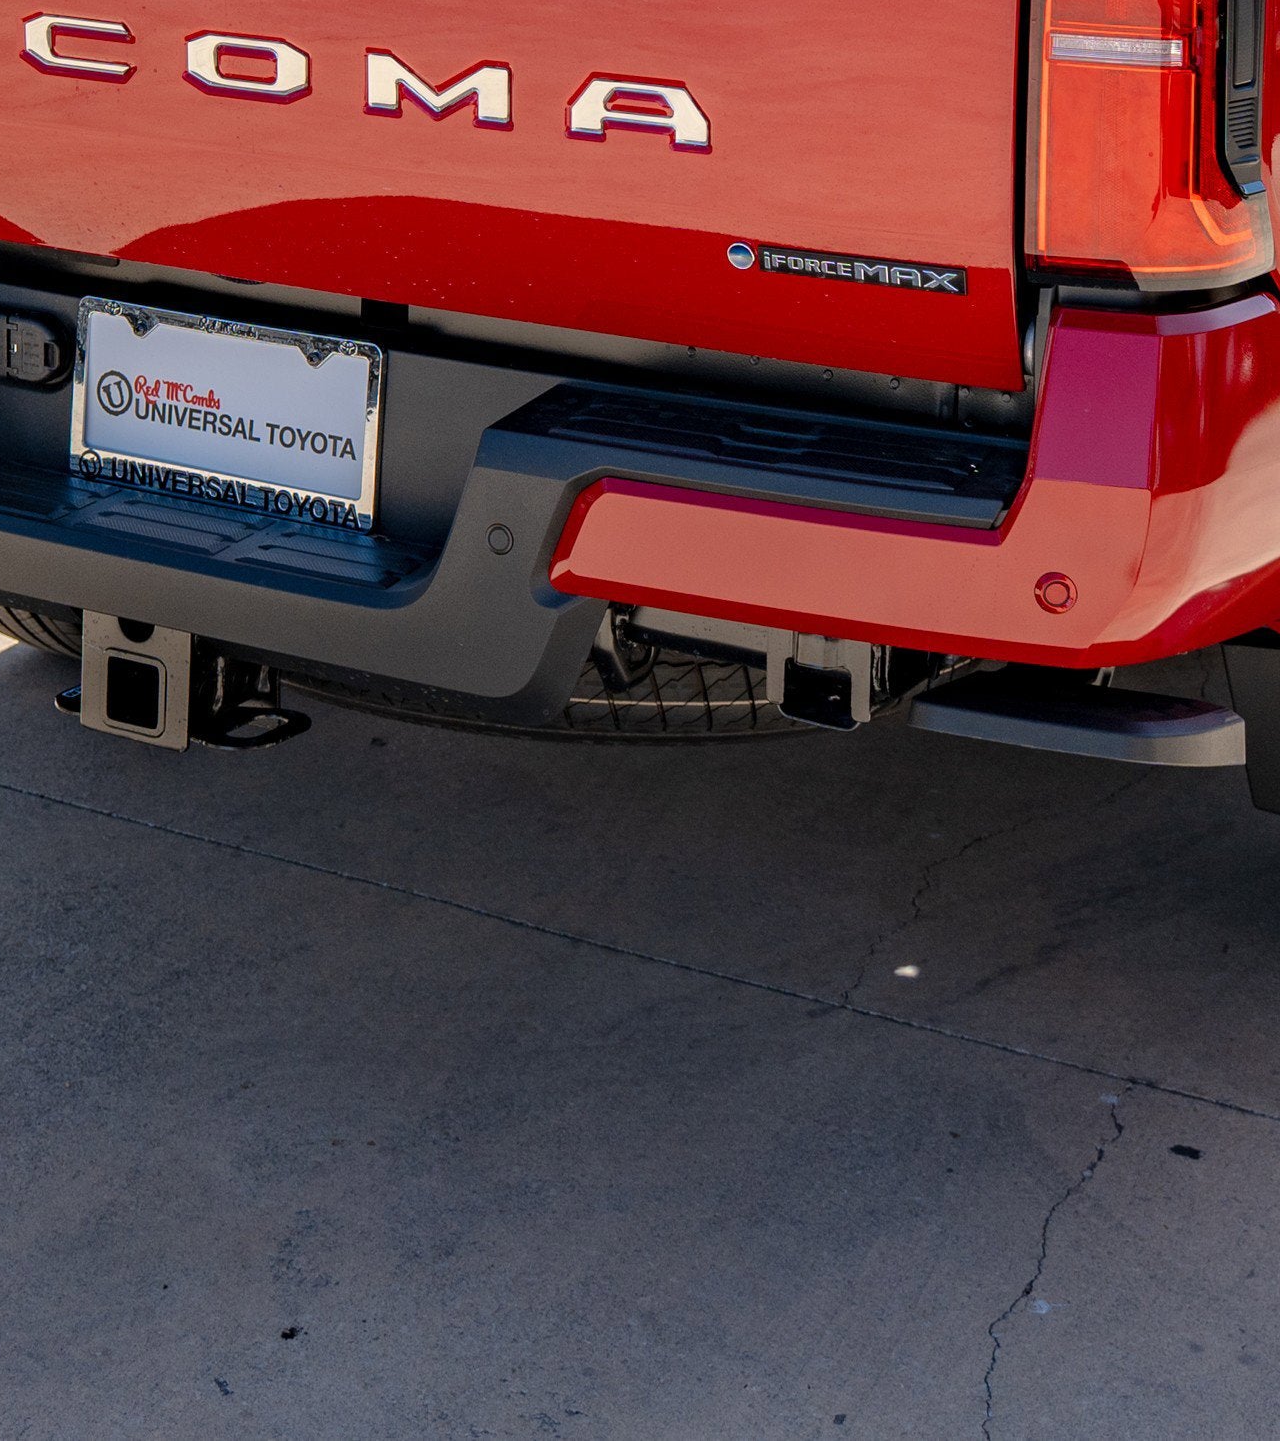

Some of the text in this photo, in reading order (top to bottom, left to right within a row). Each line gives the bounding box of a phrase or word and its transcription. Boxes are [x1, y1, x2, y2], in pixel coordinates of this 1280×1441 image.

[134, 375, 160, 404] Red
[134, 398, 357, 460] UNIVERSAL TOYOTA
[111, 456, 362, 529] UNIVERSAL TOYOTA
